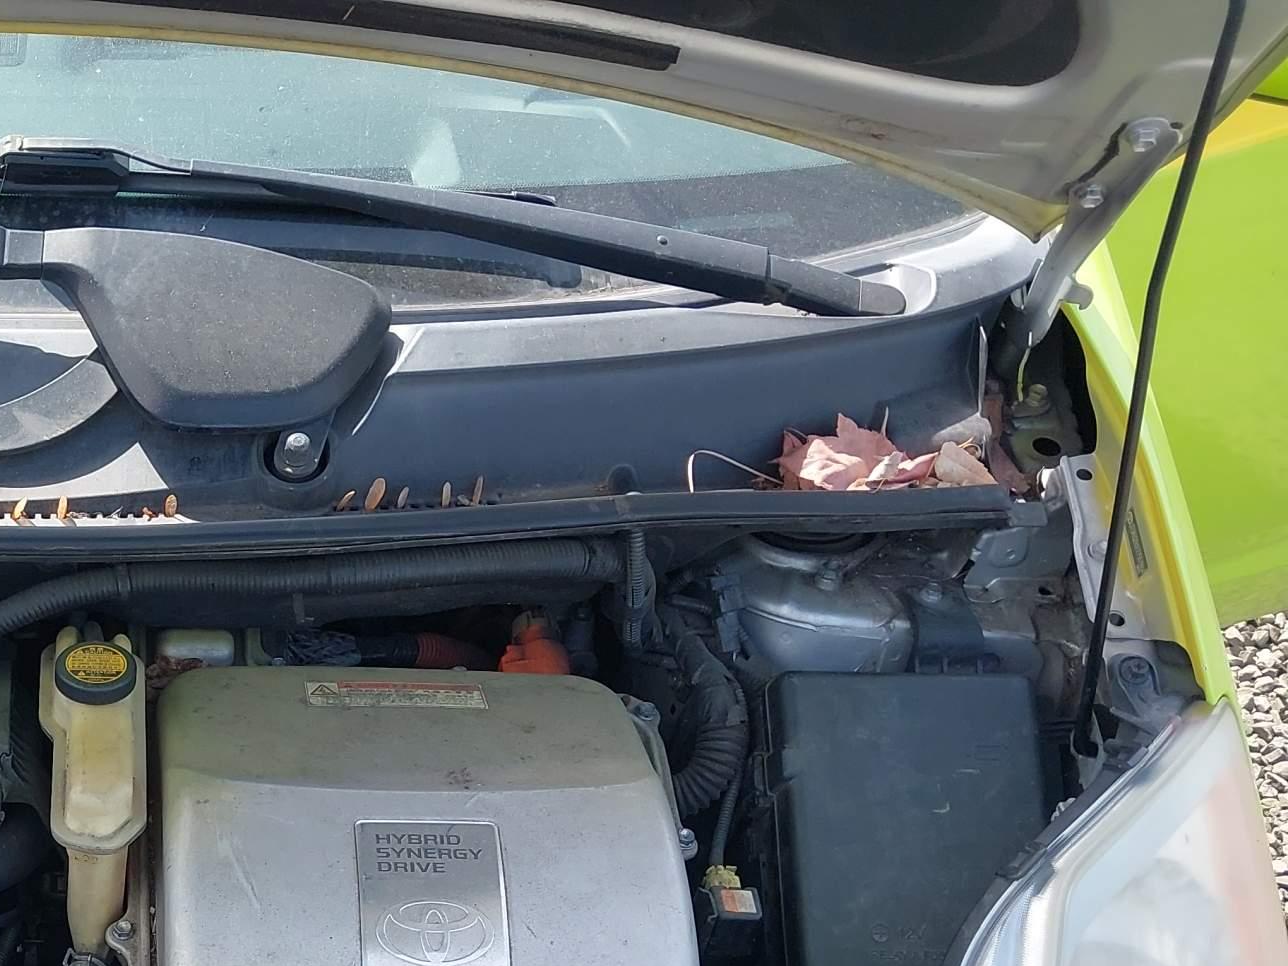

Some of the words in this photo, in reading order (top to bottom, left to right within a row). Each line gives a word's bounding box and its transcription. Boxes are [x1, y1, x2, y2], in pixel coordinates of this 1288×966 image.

[375, 833, 461, 846] HYBRID
[375, 847, 483, 860] SYNERGY
[377, 861, 447, 873] DRIVE
